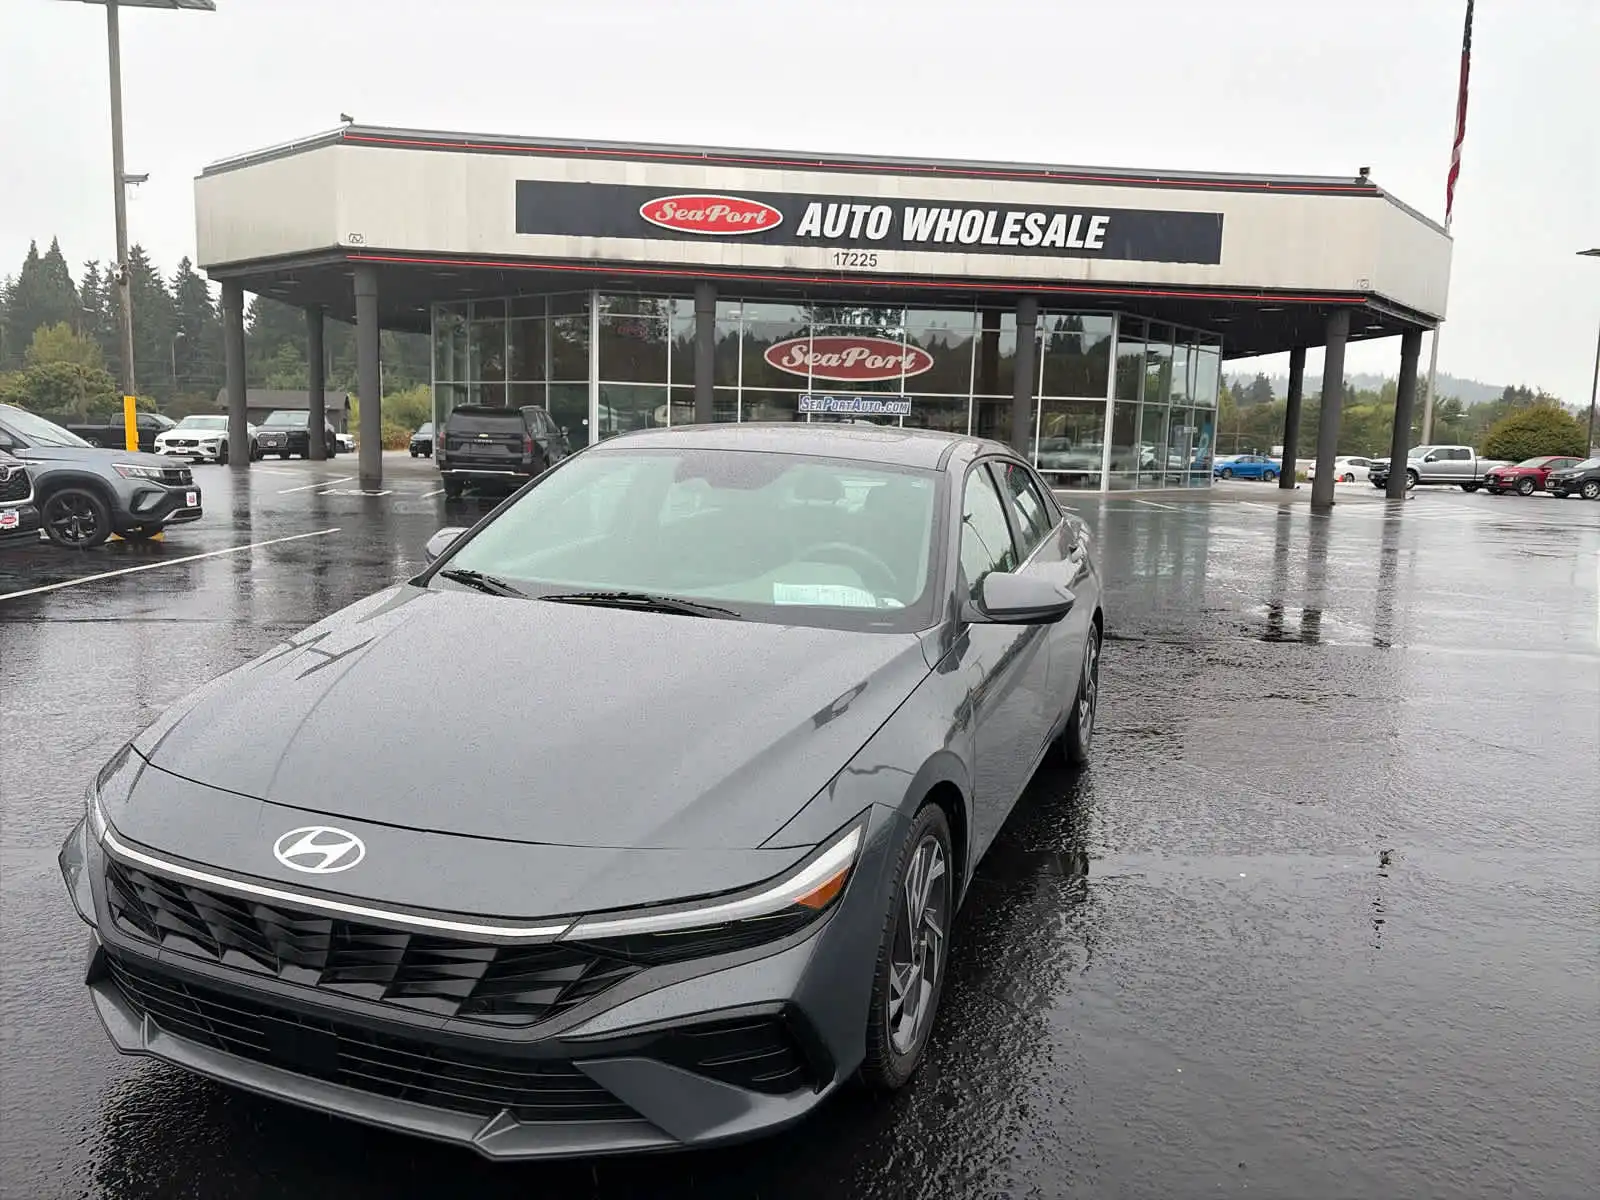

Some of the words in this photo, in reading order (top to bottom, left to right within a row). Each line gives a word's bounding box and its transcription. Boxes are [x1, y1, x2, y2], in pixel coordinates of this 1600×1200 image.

[655, 202, 767, 224] SeaPort
[797, 202, 892, 240] AUTO
[902, 207, 1110, 249] WHOLESALE
[833, 252, 878, 267] 17225
[782, 345, 916, 369] SeaPort
